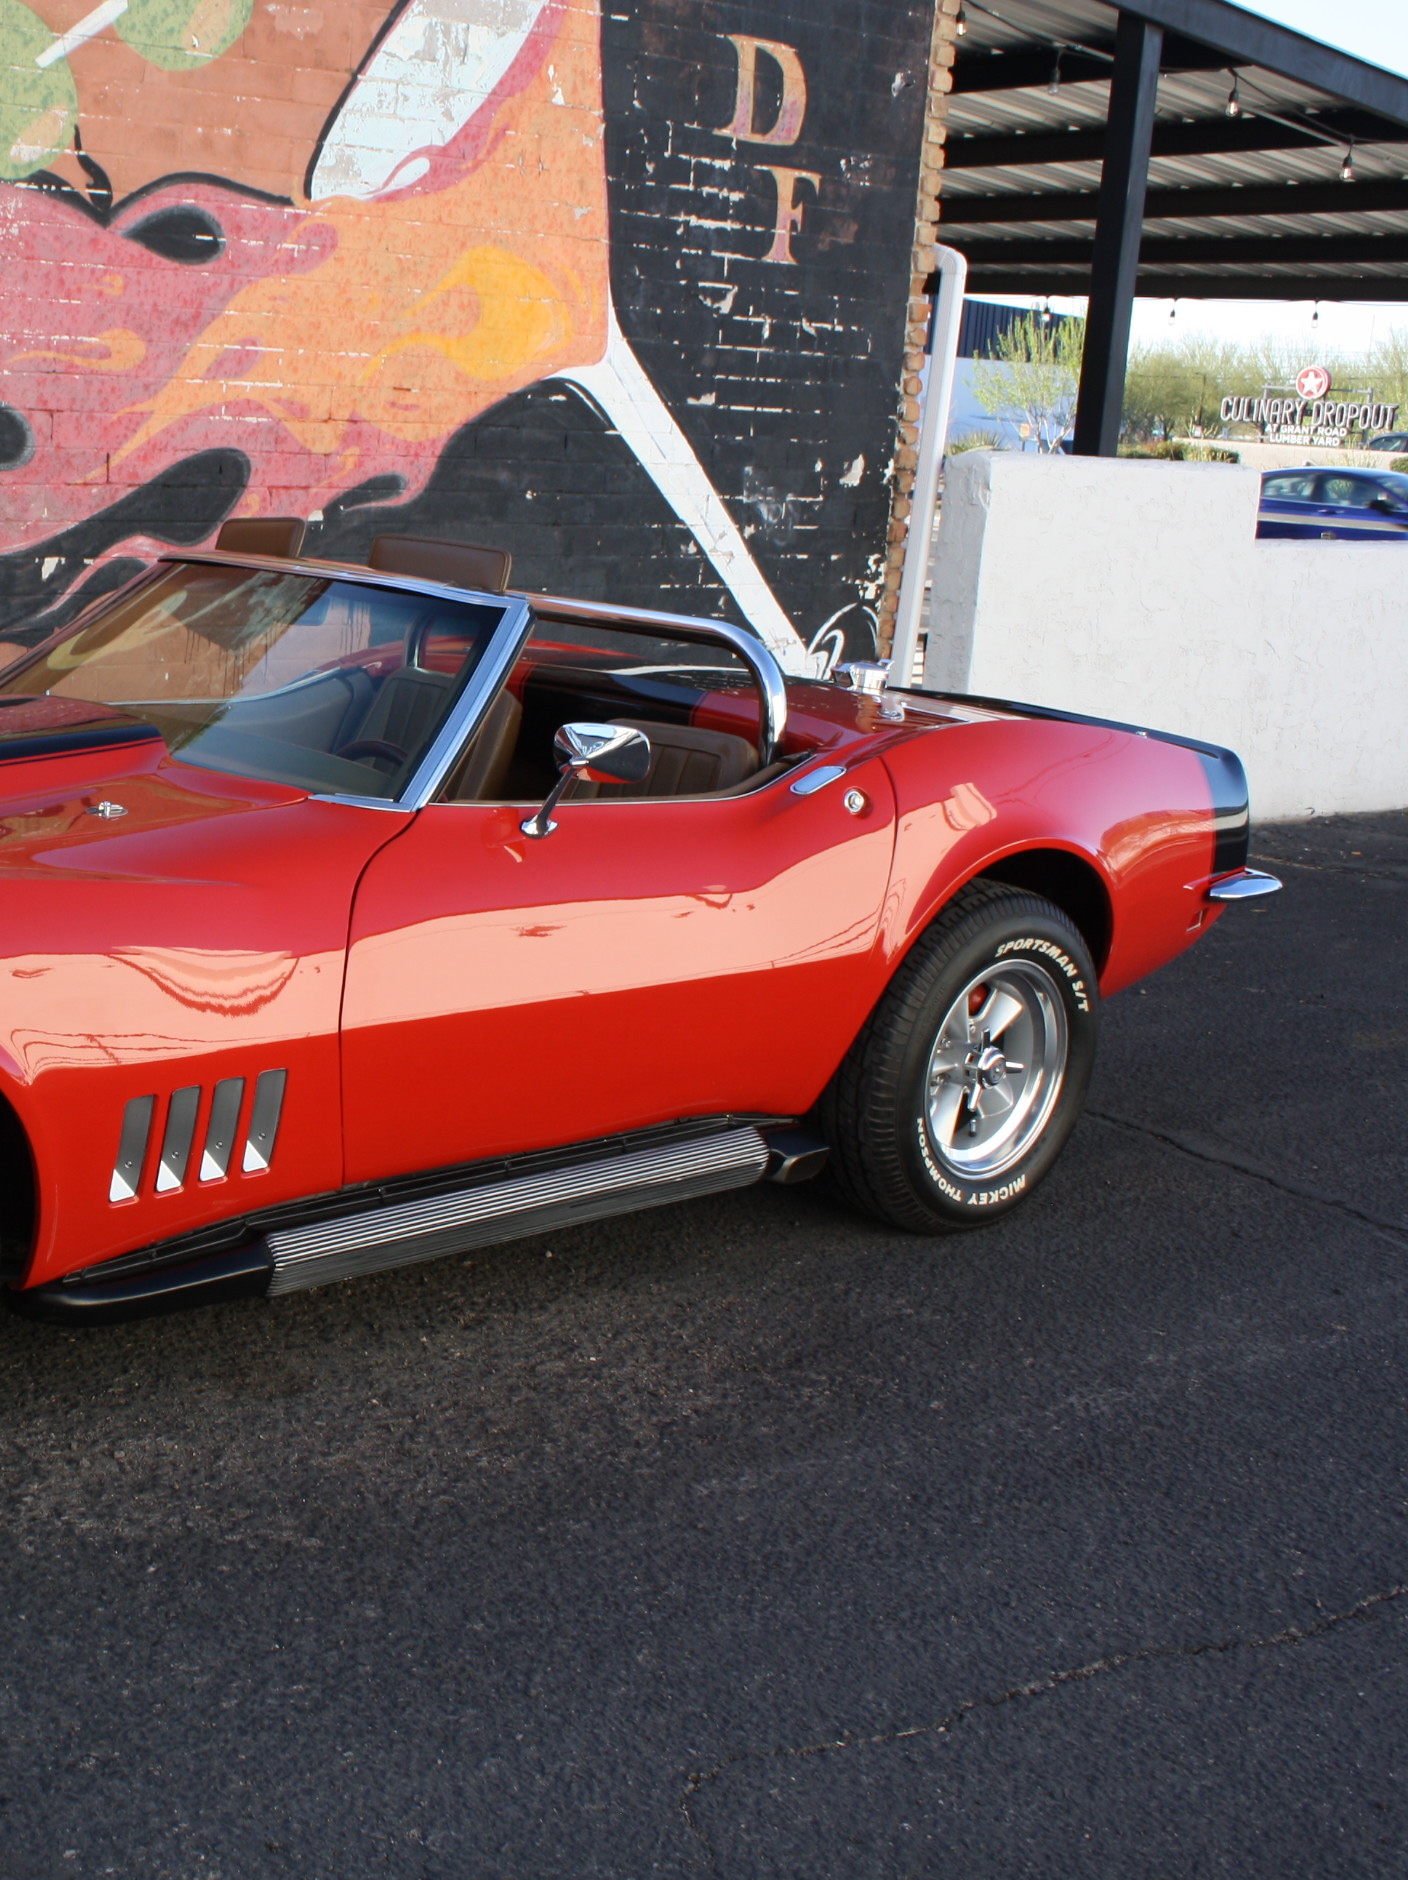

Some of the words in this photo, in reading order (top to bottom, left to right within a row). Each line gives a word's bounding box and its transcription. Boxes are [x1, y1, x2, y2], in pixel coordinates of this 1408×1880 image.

[712, 34, 808, 146] D
[757, 165, 822, 264] F
[1220, 397, 1307, 425] CULINARY
[1311, 402, 1398, 430] DROPOUT
[1265, 424, 1280, 433] AT
[1281, 425, 1315, 435] GRANT
[1317, 426, 1348, 437] ROAD
[1269, 433, 1309, 445] LUMBER
[1312, 436, 1340, 446] YARD
[995, 938, 1077, 978] SPORTSMAN
[1072, 981, 1089, 1012] S/T
[916, 1117, 962, 1202] THOMPSON
[967, 1174, 1026, 1205] MICKEY
